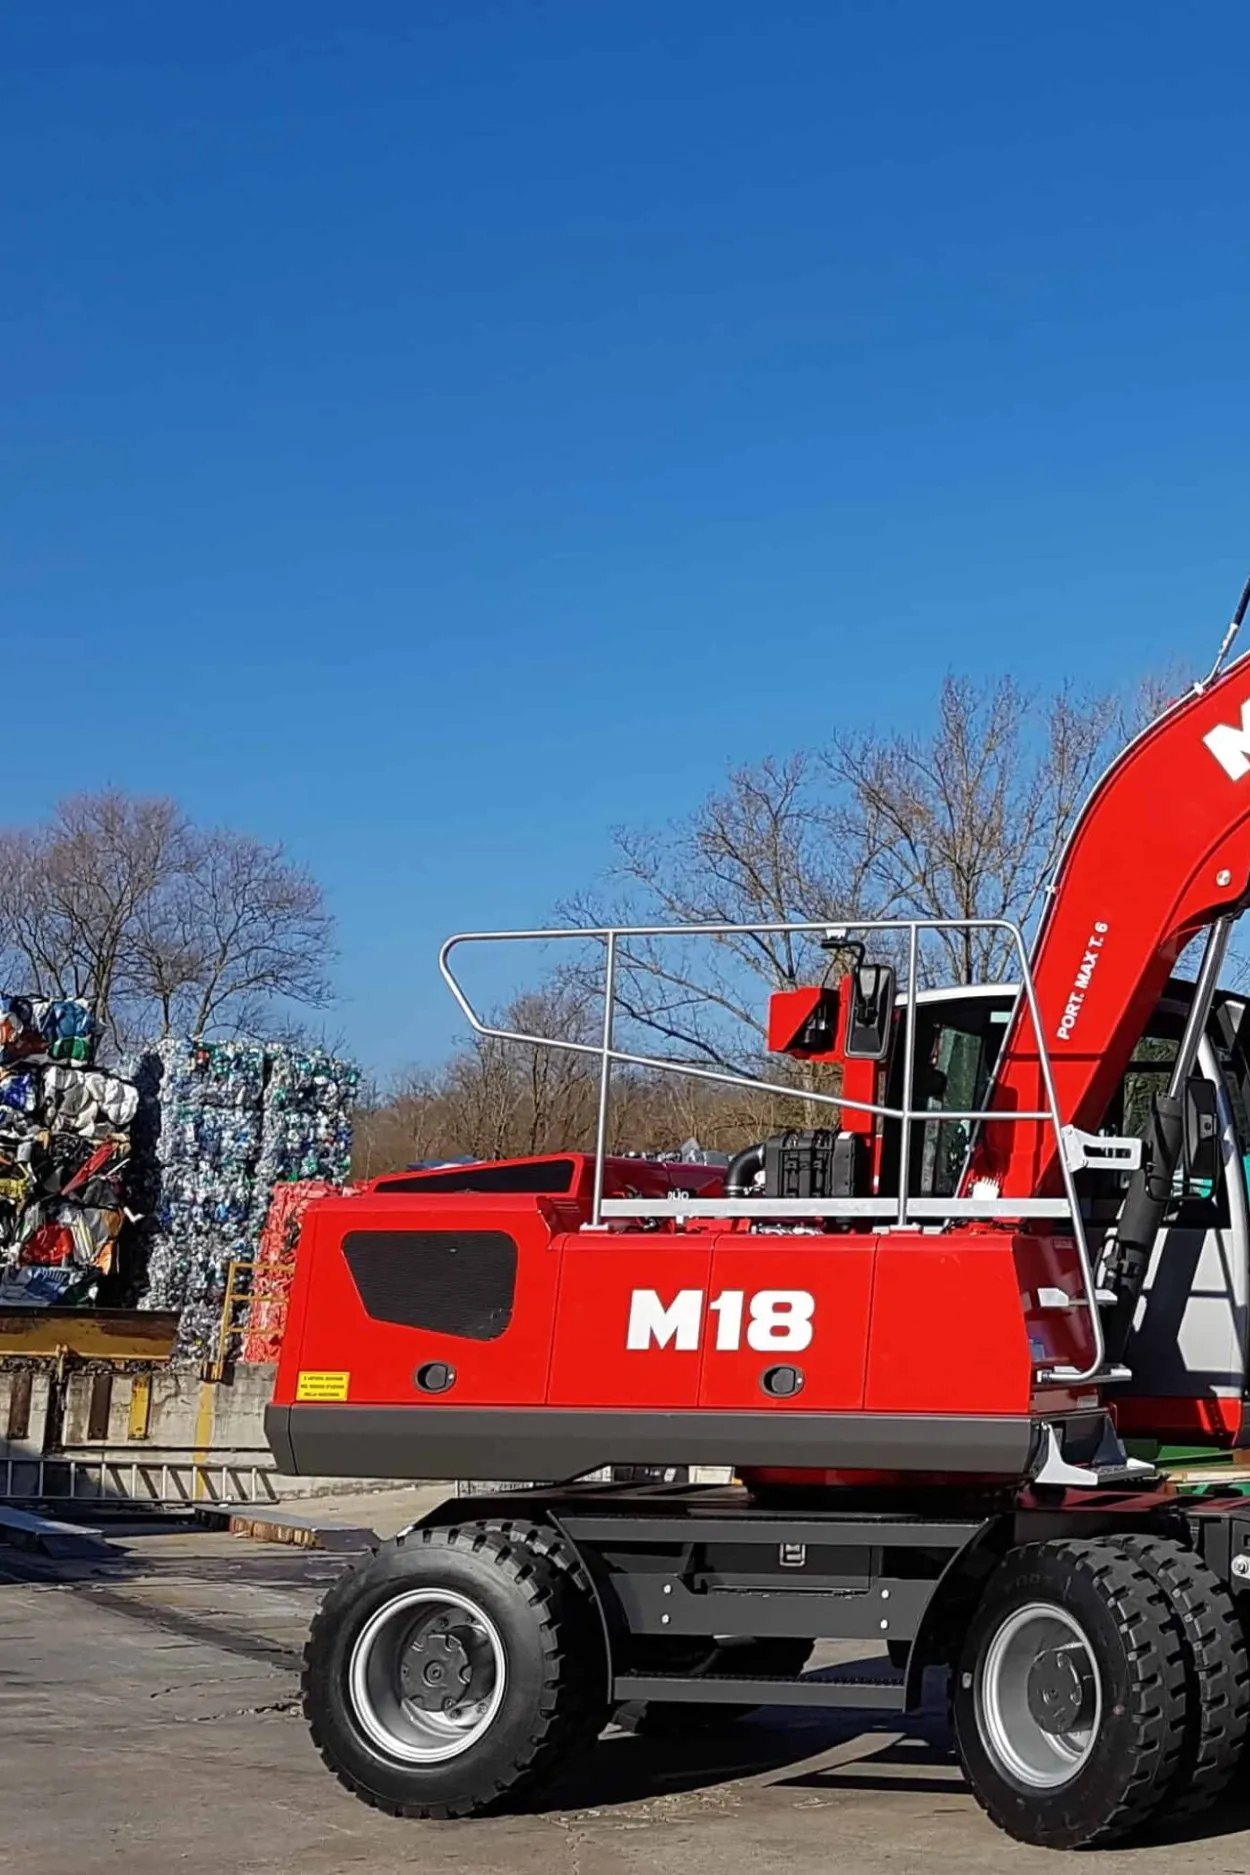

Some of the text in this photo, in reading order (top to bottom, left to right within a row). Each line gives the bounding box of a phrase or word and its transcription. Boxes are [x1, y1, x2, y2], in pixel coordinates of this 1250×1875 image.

[1056, 921, 1109, 1040] PORT. MAX T. 6
[626, 1289, 816, 1352] M18
